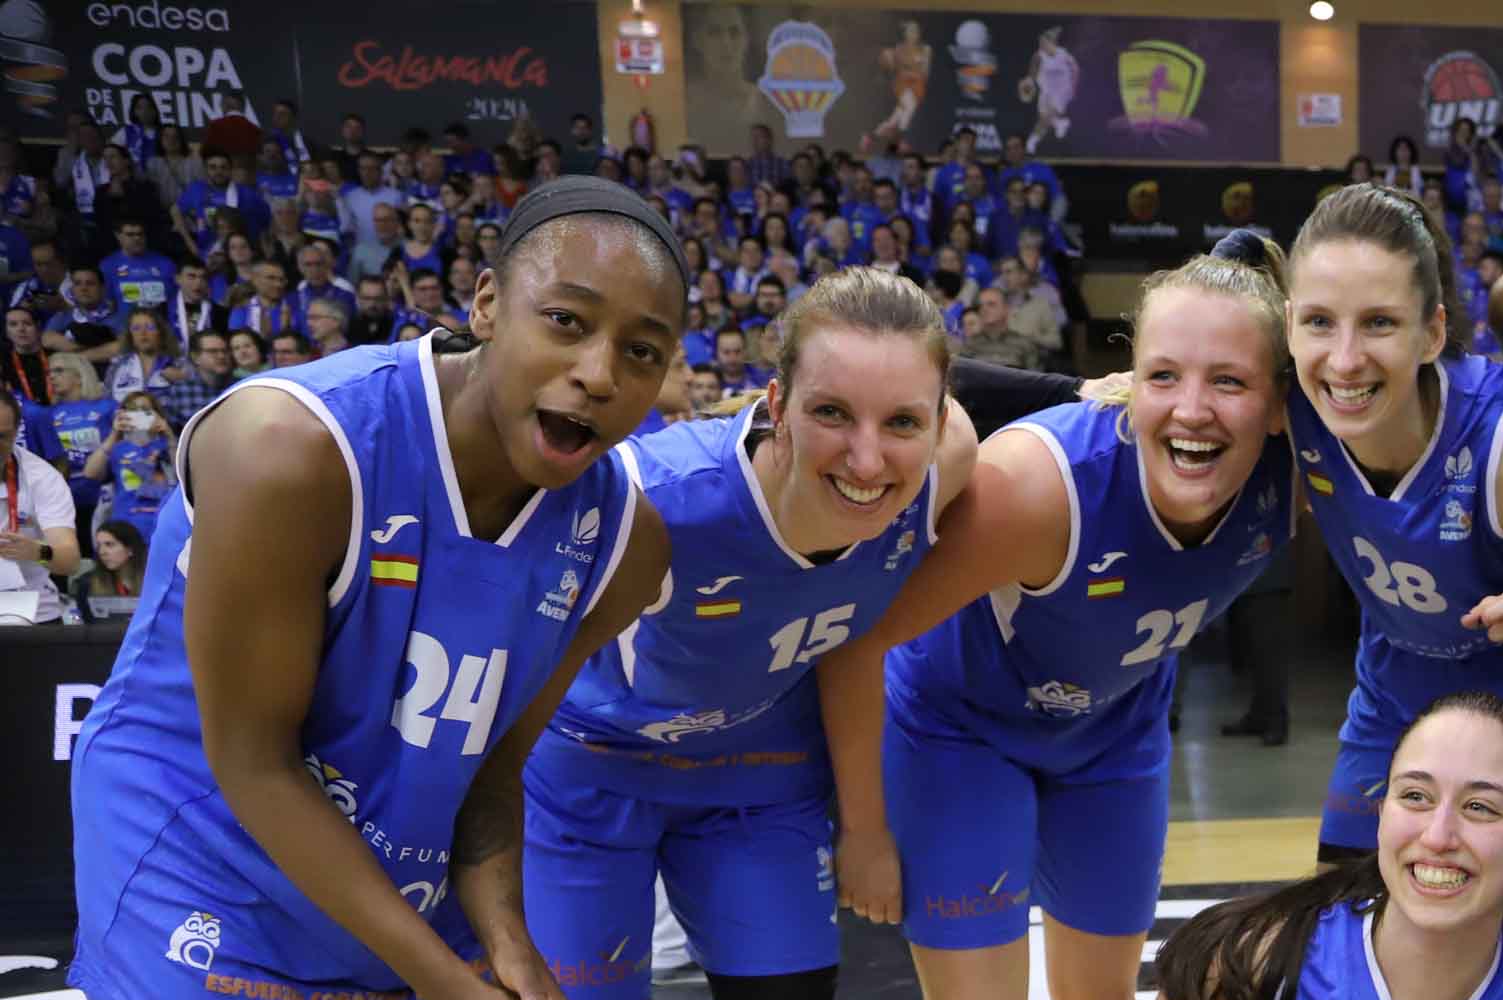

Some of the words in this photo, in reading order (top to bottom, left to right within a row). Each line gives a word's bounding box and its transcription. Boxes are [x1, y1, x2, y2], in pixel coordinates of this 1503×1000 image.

[87, 2, 230, 31] endesa
[86, 88, 113, 105] DE
[93, 43, 243, 89] COPA
[1352, 536, 1448, 614] 28
[768, 603, 856, 673] 15
[1120, 599, 1209, 667] 21
[391, 630, 508, 756] 24
